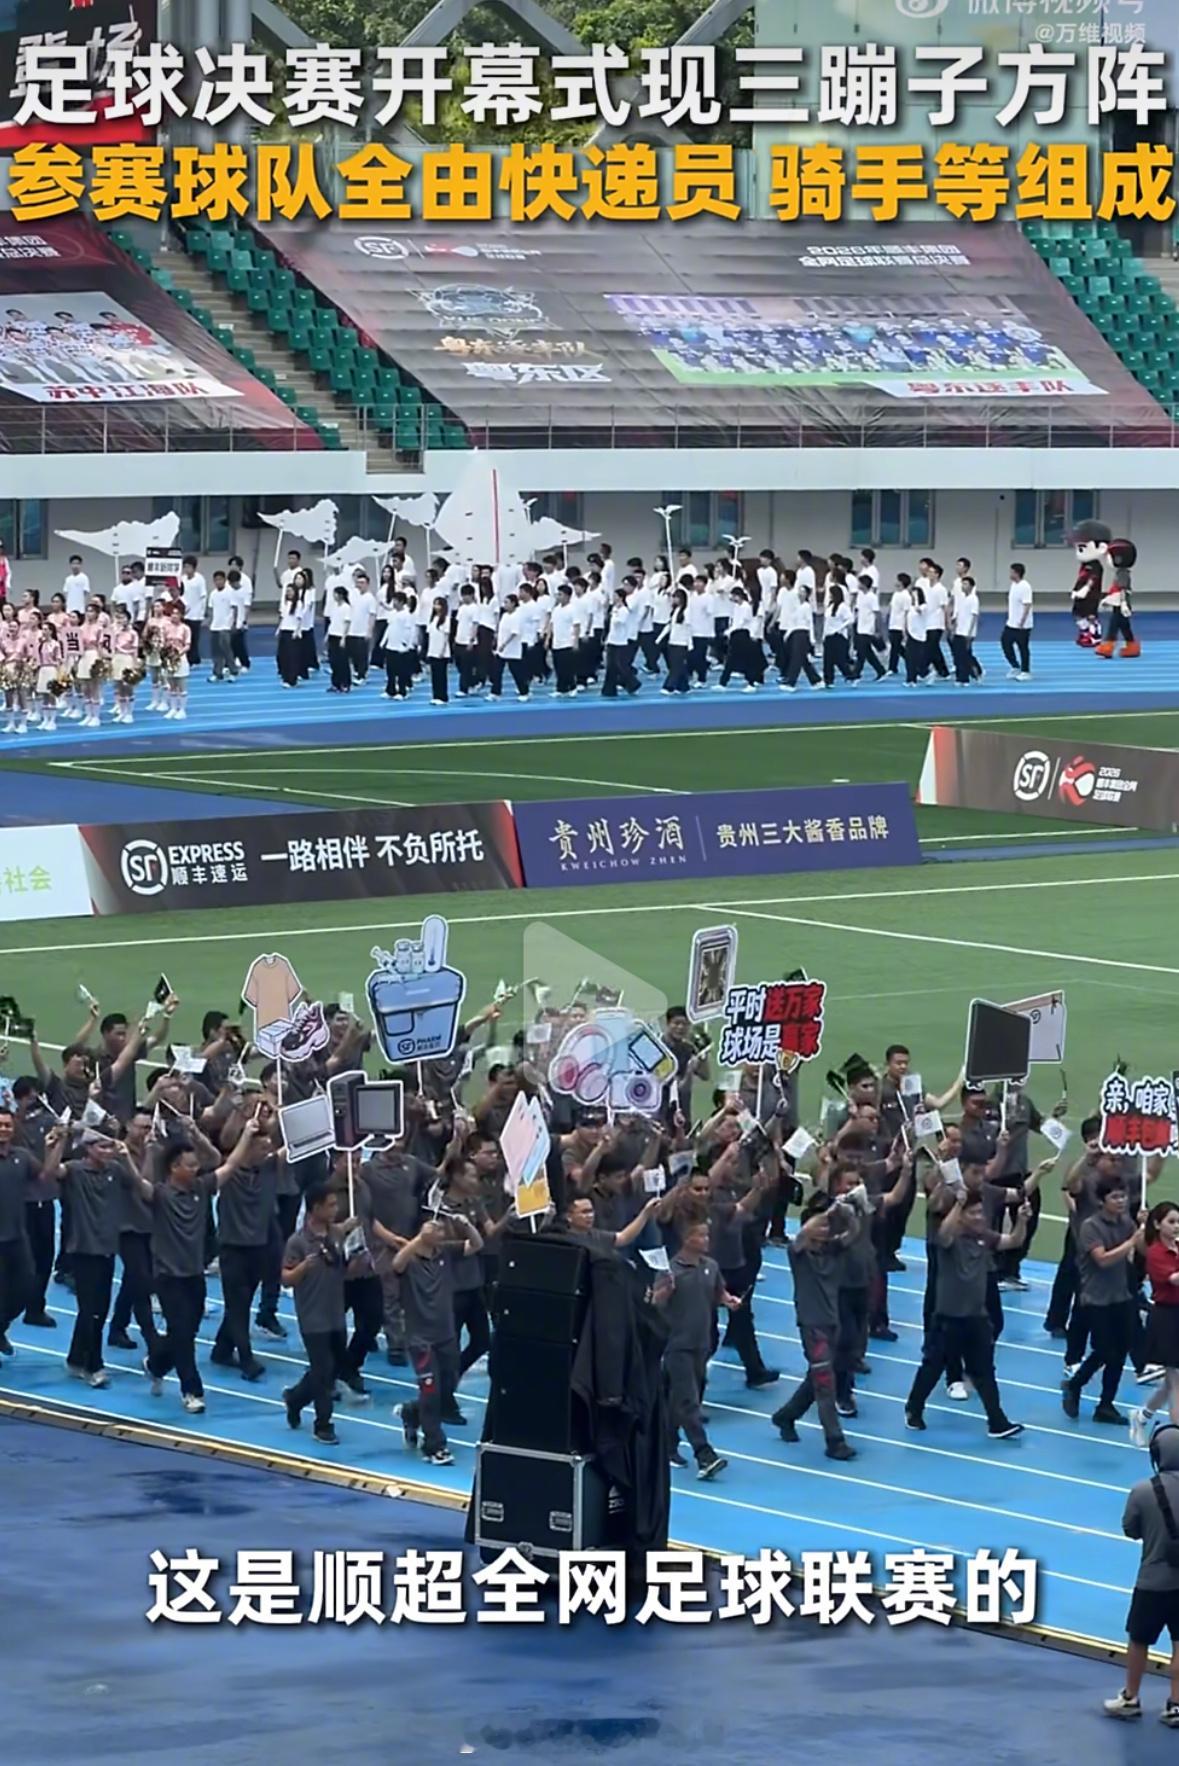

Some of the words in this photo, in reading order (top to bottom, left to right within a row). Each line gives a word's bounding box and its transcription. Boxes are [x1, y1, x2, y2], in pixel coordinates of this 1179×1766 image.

[0, 235, 48, 247] 集团
[0, 246, 61, 259] 总决赛
[460, 362, 613, 386] 粤东区
[42, 381, 210, 400] 苏中江海队
[548, 815, 685, 861] 贵州珍酒
[716, 815, 890, 849] 贵州三大酱香品牌
[128, 853, 159, 882] SF
[167, 841, 245, 865] EXPRESS
[260, 832, 371, 874] 一路相伴
[374, 828, 485, 868] 不负所托
[560, 857, 641, 872] KWEICHOW
[649, 854, 688, 866] ZHEN
[0, 864, 53, 895] 社会
[171, 862, 248, 886] 顺丰速运
